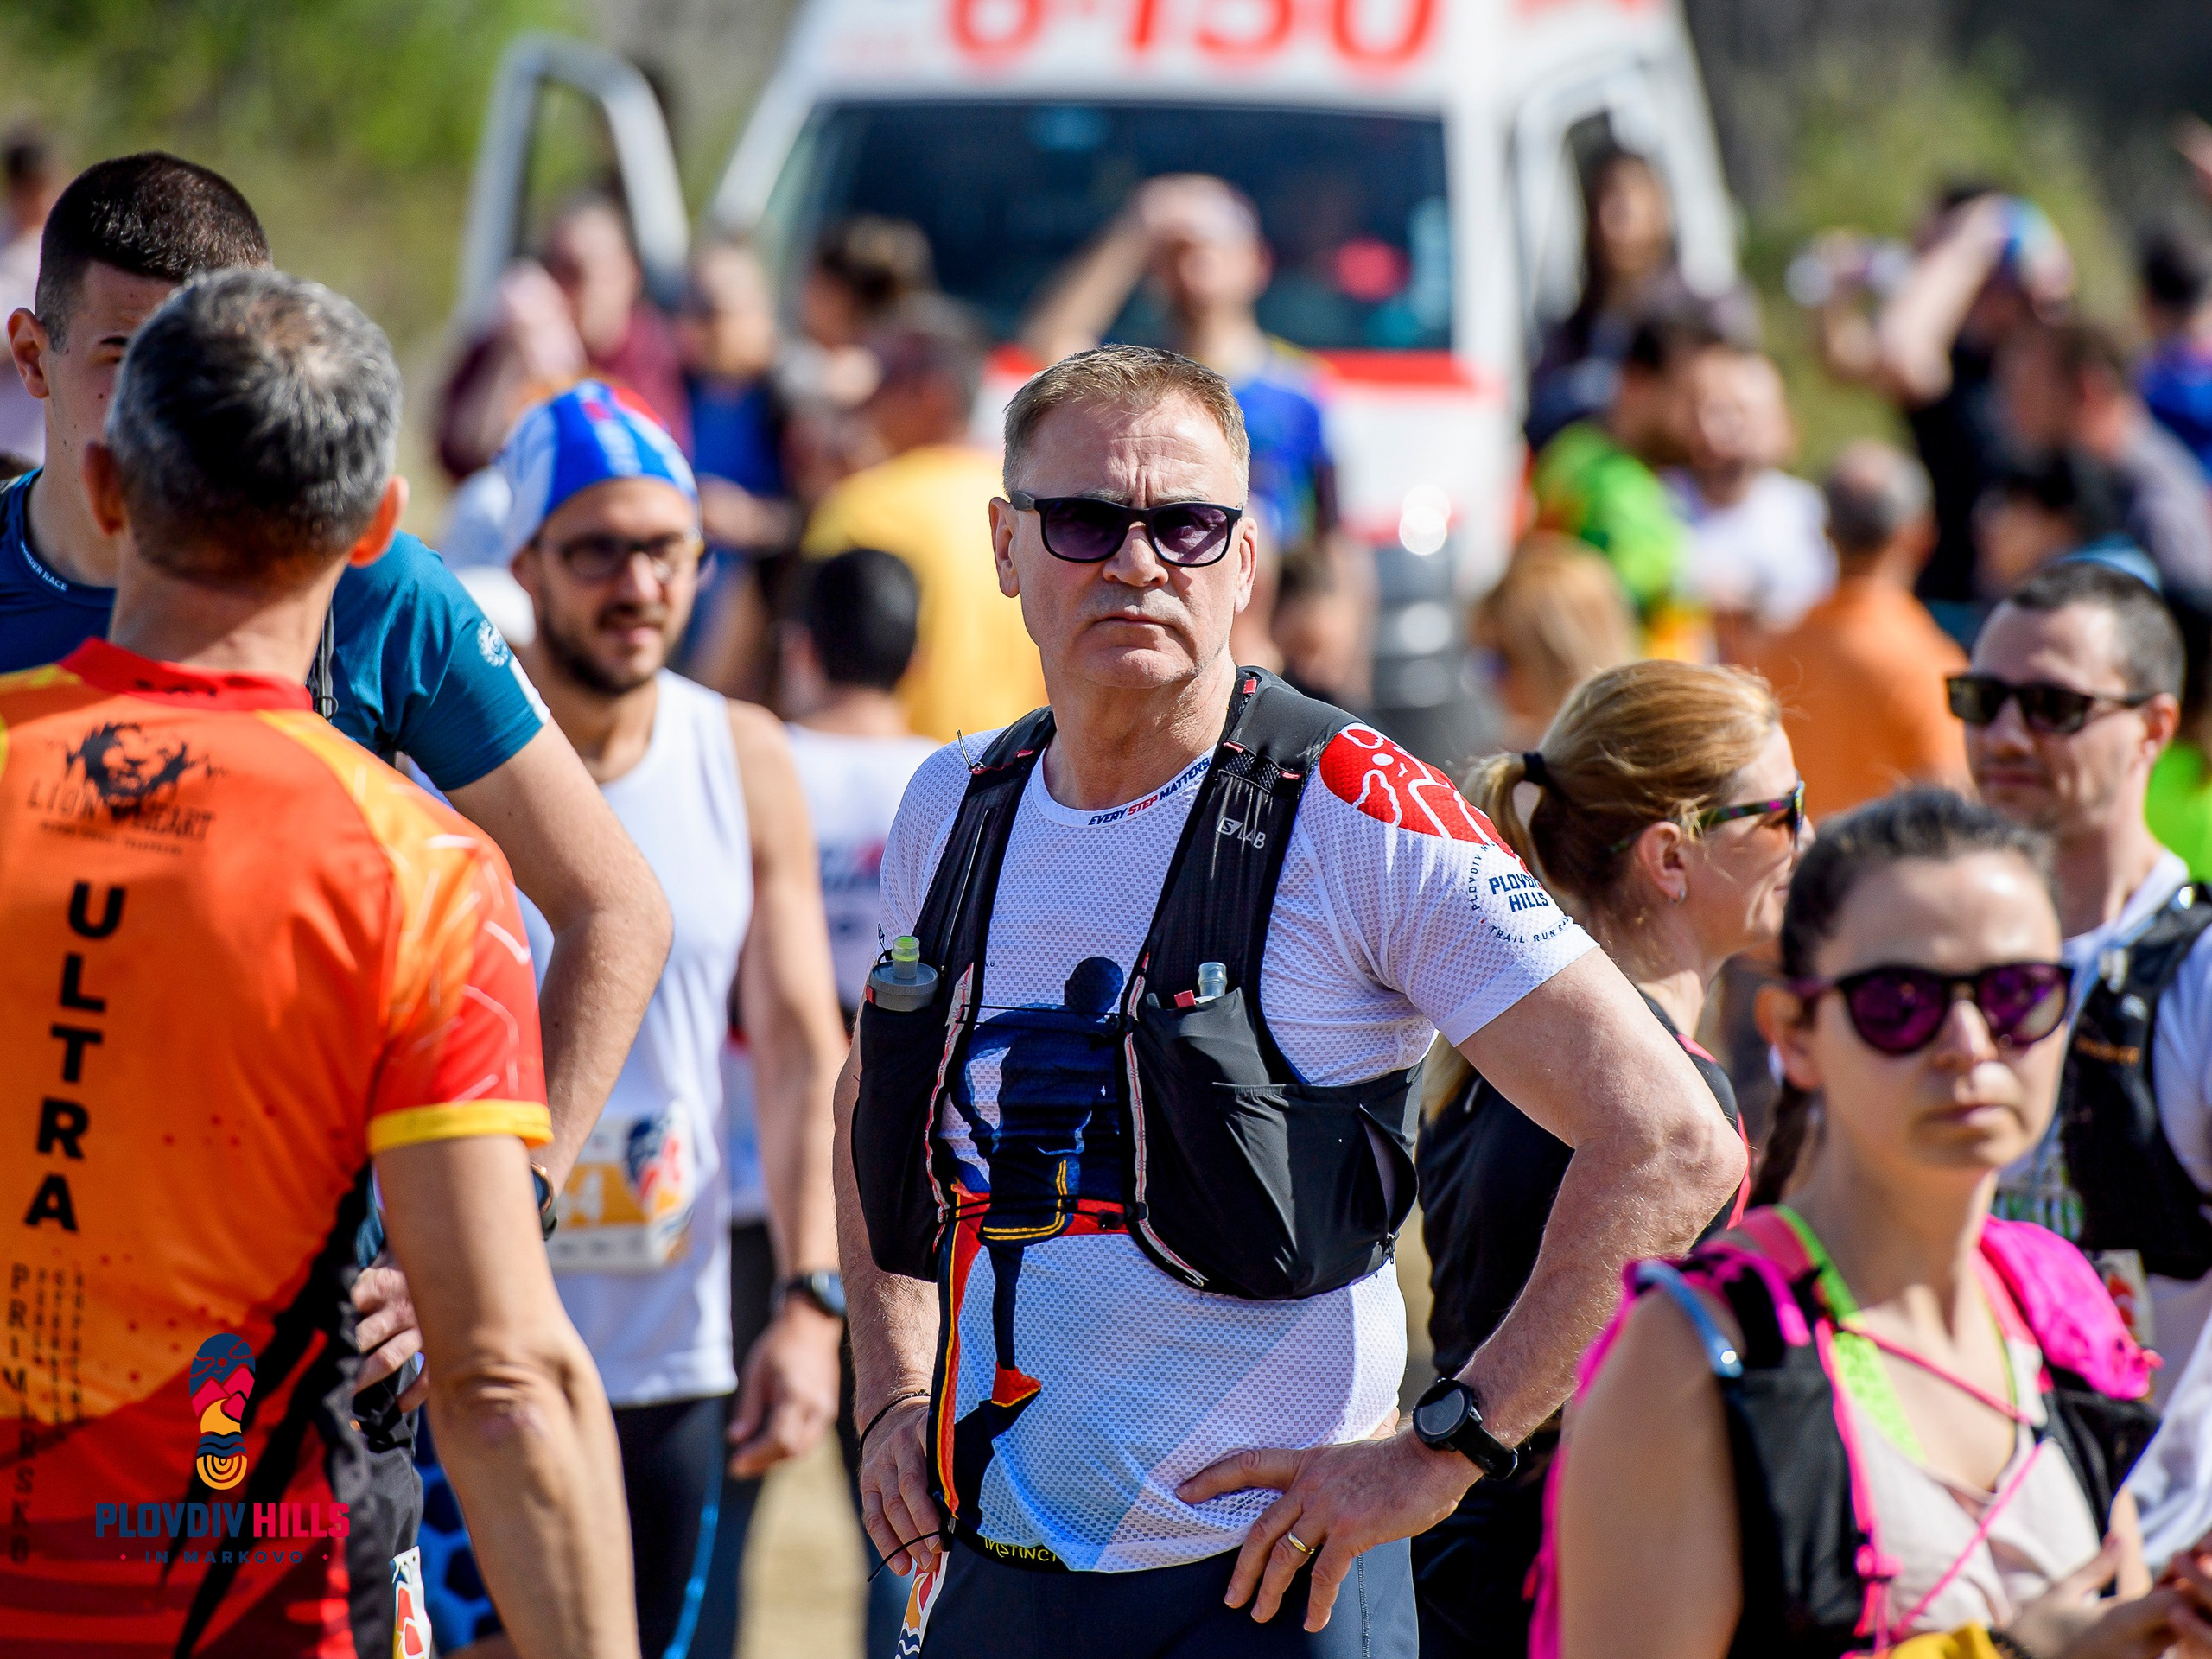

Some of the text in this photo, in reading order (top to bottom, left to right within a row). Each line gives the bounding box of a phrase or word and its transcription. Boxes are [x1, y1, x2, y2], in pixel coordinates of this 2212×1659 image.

[41, 571, 68, 591] RACE
[1087, 756, 1211, 826] EVERY STEP MATTERS
[1508, 891, 1549, 912] HILLS
[1487, 925, 1555, 944] TRAIL RUN
[23, 880, 126, 1233] ULTRA
